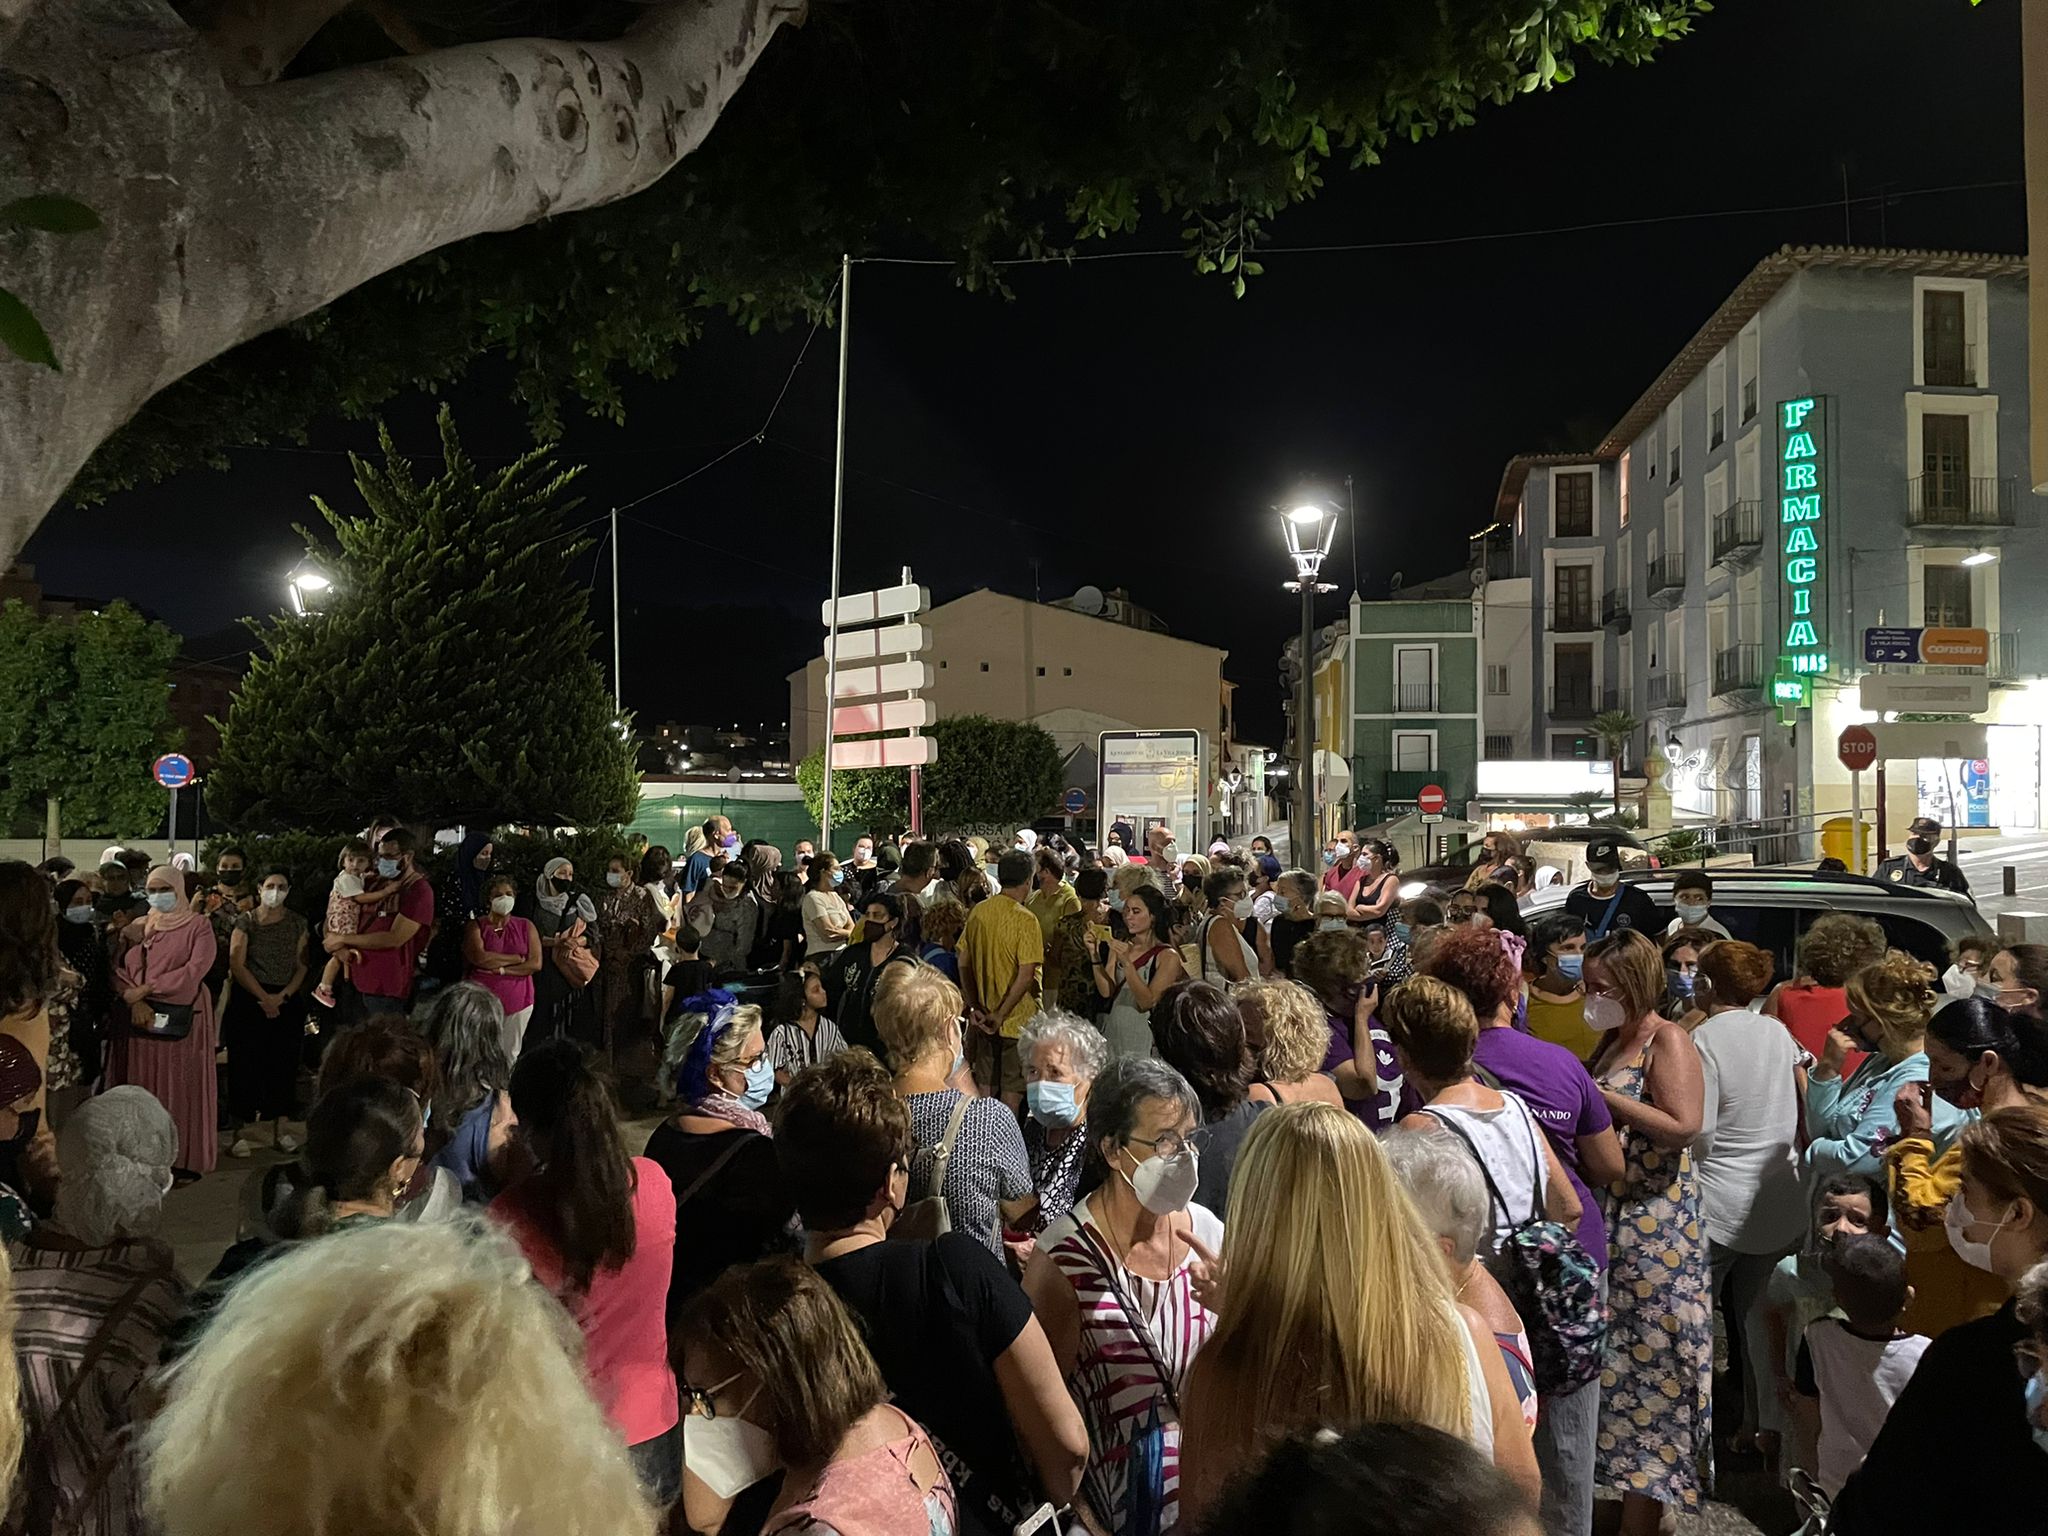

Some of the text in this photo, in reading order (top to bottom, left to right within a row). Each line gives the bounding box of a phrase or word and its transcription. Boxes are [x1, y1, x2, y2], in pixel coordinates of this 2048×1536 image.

[1783, 398, 1820, 647] FARMACIA
[1876, 650, 1885, 659] P
[1927, 645, 1983, 654] consum
[1842, 739, 1875, 756] STOP
